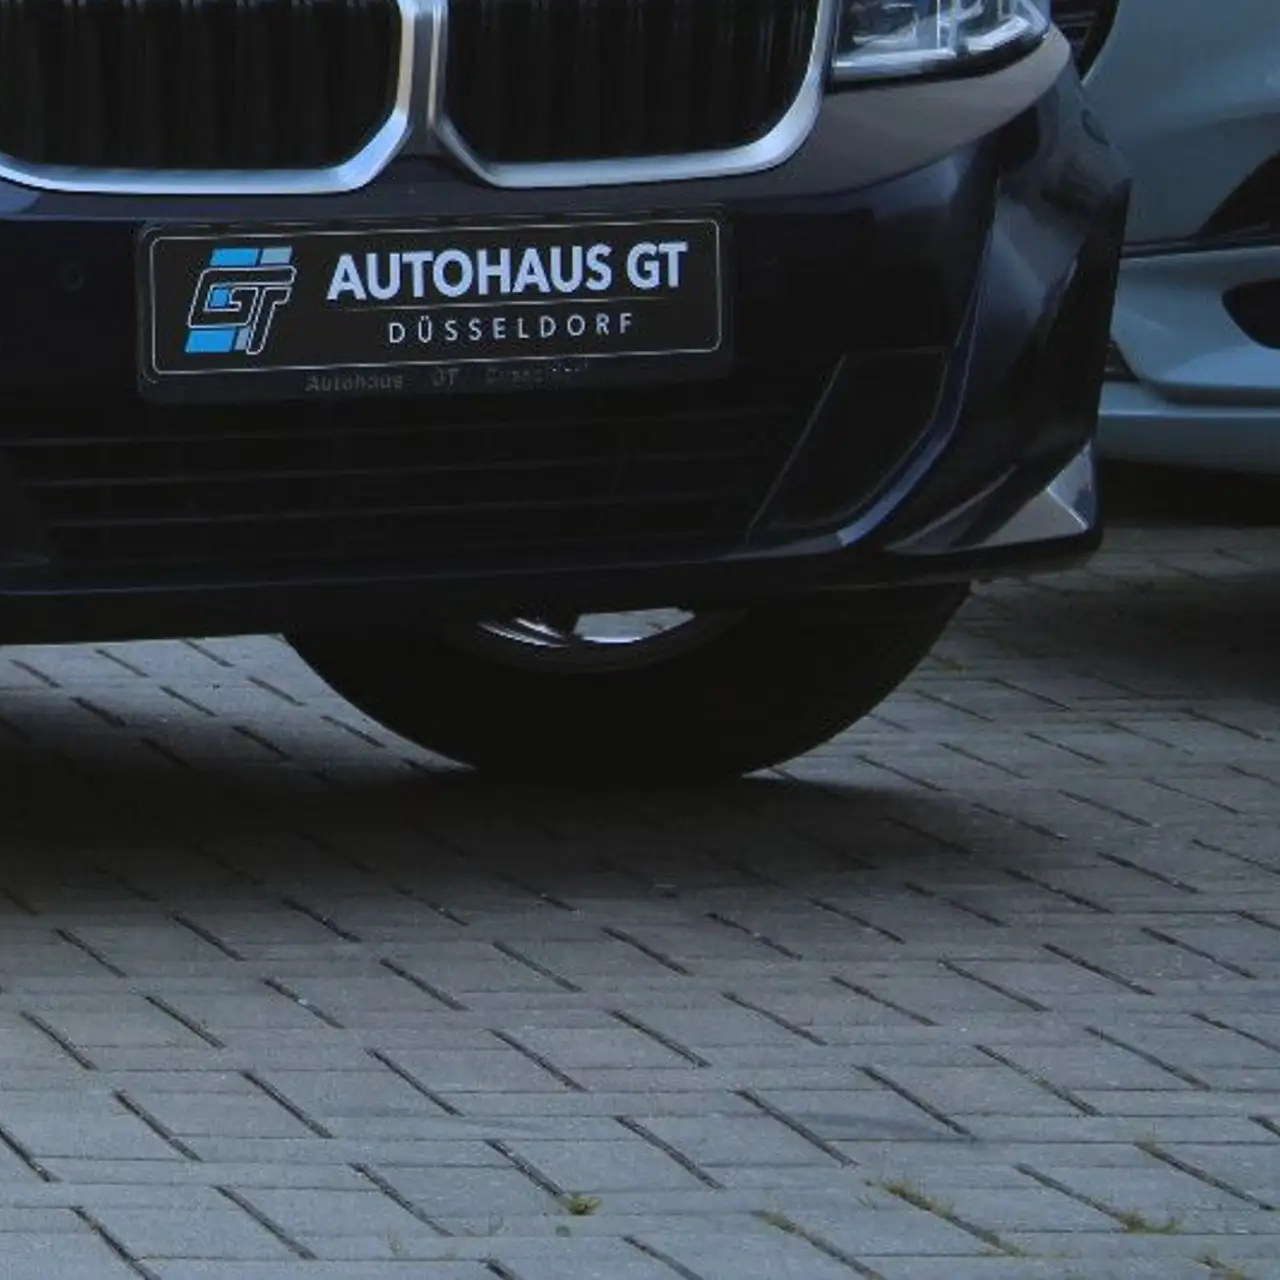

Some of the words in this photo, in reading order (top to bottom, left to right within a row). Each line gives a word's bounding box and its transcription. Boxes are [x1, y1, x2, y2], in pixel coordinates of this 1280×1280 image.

[326, 244, 613, 301] AUTOHAUS
[626, 241, 689, 290] GT
[387, 312, 635, 345] DÜSSELDORF
